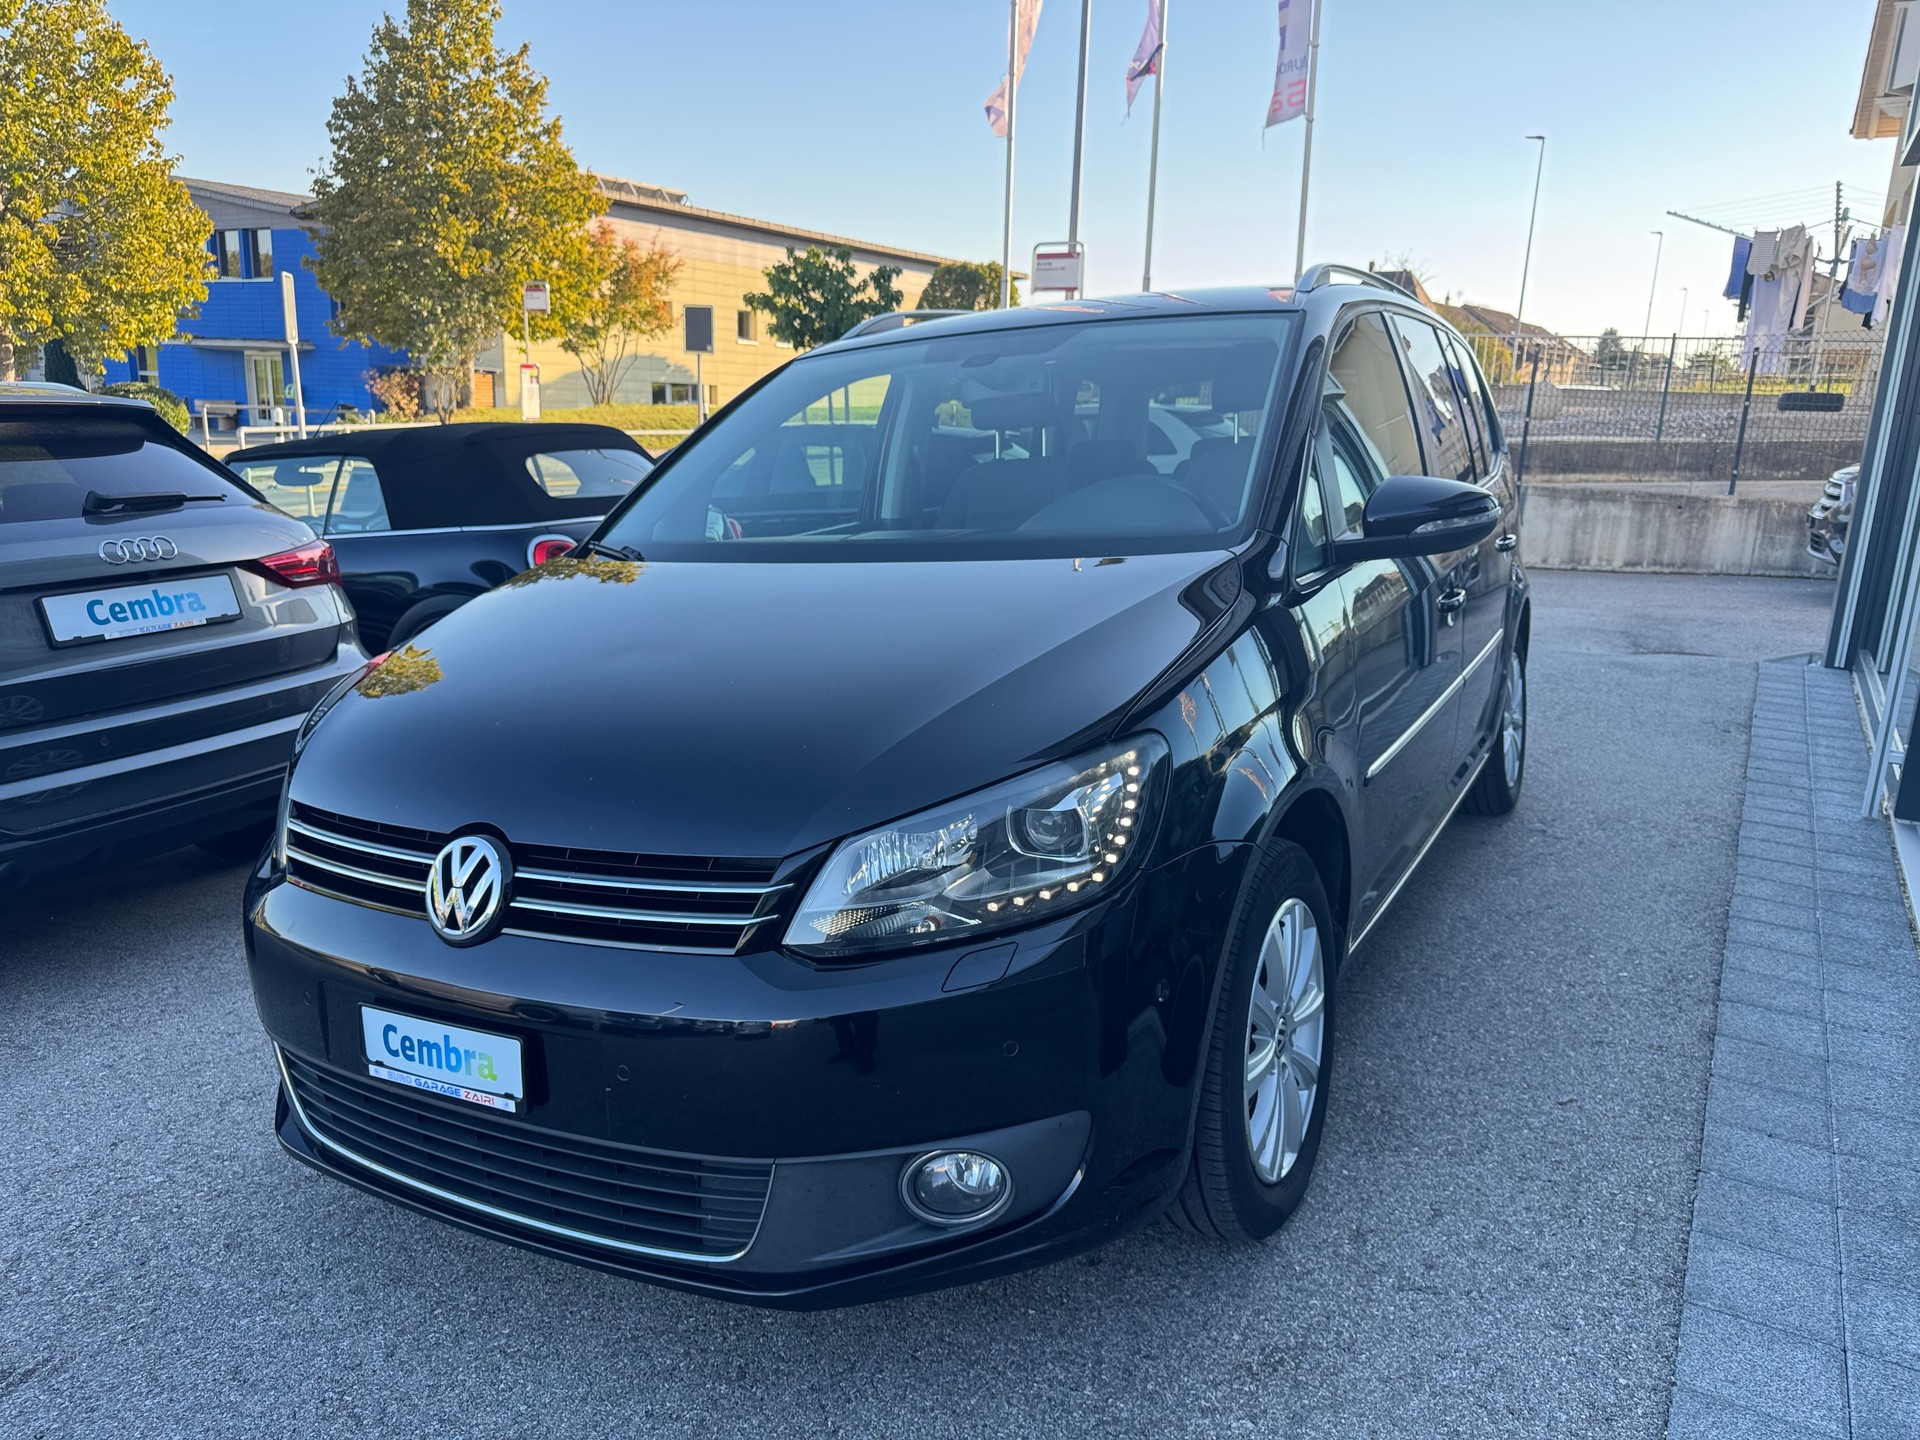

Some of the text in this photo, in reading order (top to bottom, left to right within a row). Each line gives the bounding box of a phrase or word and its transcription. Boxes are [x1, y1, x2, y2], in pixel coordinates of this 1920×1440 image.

[86, 589, 206, 625] Cembra
[383, 1024, 497, 1082] Cembra
[414, 1078, 462, 1097] GARAGE
[464, 1090, 495, 1105] ZAIRI
